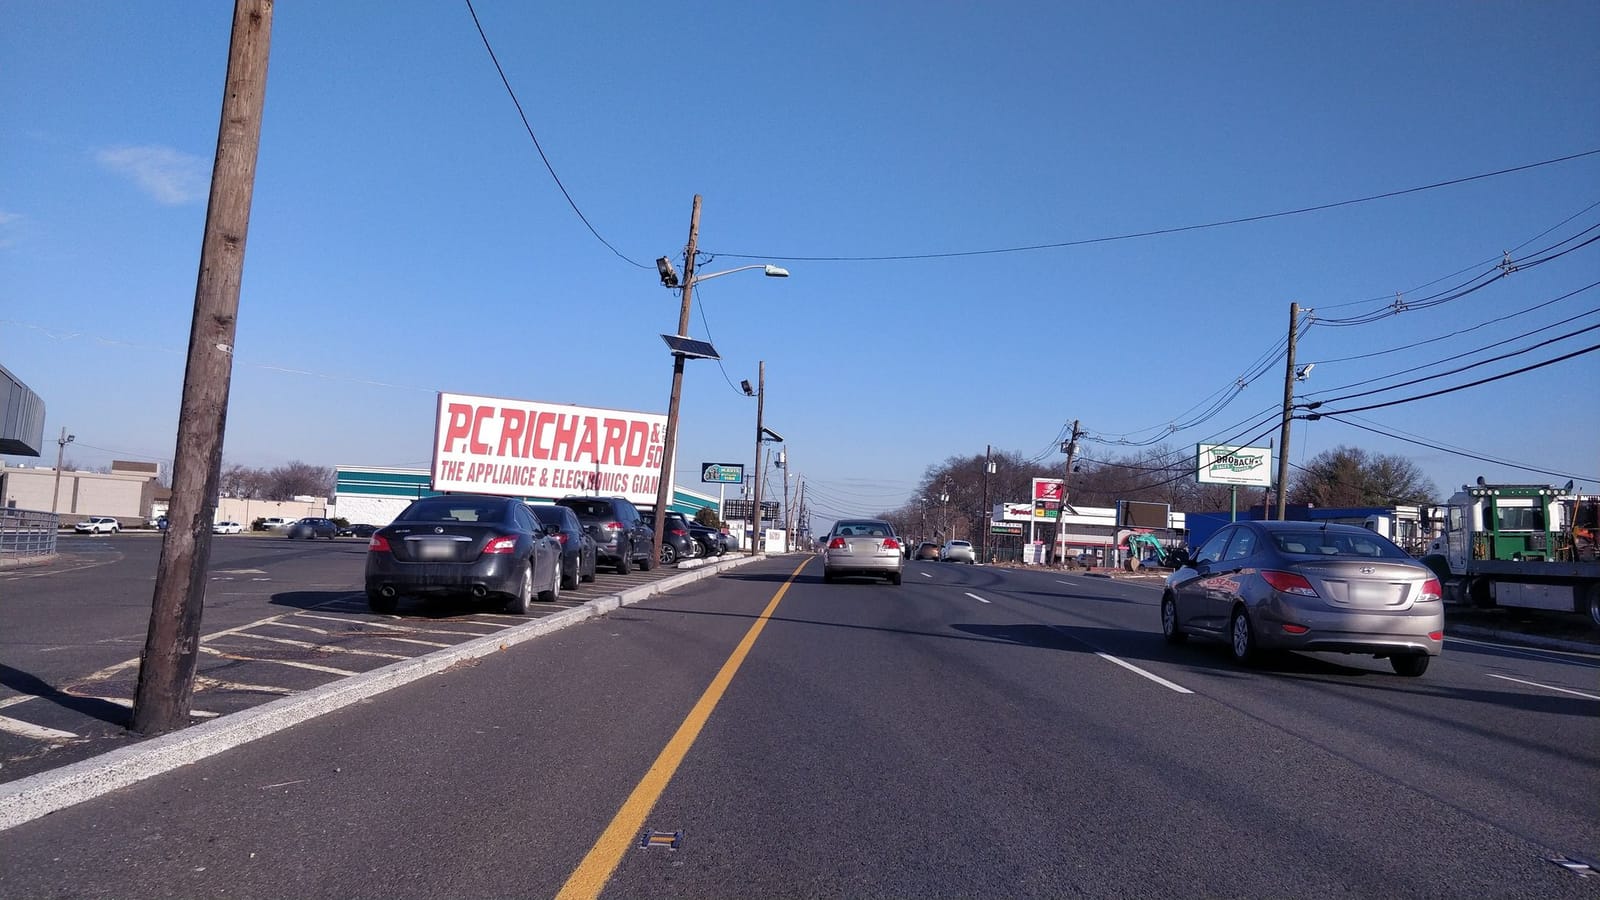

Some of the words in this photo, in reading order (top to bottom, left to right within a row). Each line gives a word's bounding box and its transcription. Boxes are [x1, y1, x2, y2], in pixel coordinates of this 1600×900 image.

[497, 407, 650, 468] RICHARD
[646, 445, 663, 469] SO
[440, 460, 466, 482] THE
[466, 461, 535, 487] APPLIANCE
[539, 467, 549, 487] &
[552, 468, 629, 493] ELECTRONICS
[632, 473, 659, 494] GIAN
